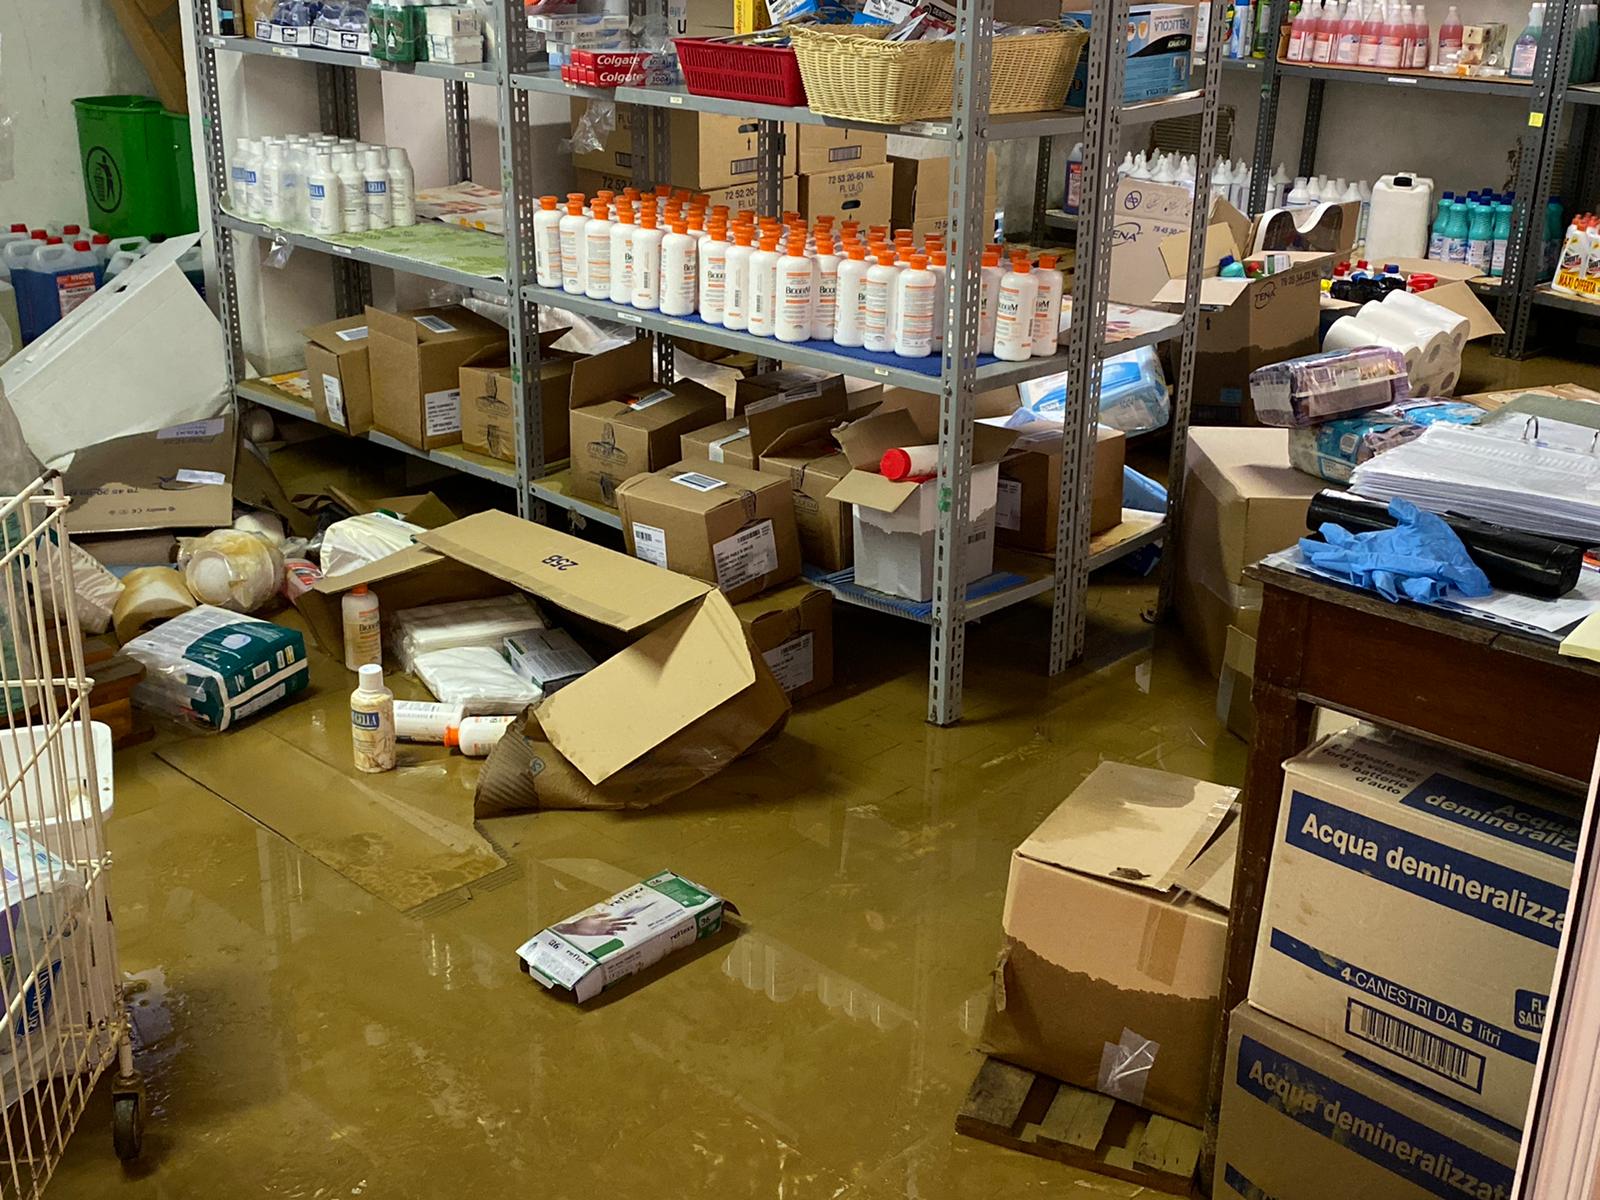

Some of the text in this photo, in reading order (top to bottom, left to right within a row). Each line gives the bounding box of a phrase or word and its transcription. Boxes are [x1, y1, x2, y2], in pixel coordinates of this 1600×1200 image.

[597, 55, 640, 67] Colgate
[600, 72, 644, 84] Colgate
[1111, 229, 1137, 242] ENA
[1574, 278, 1597, 294] OFFERTA
[1424, 794, 1578, 852] demineraliz
[1494, 804, 1579, 838] Acqua
[1301, 812, 1566, 933] Acqua demineralizza
[1341, 966, 1502, 1047] 4 CANESTRI DA 5 litri
[1531, 997, 1546, 1013] FL
[1518, 1010, 1547, 1029] SALV
[1248, 1059, 1510, 1200] Acqua demineralizzat
